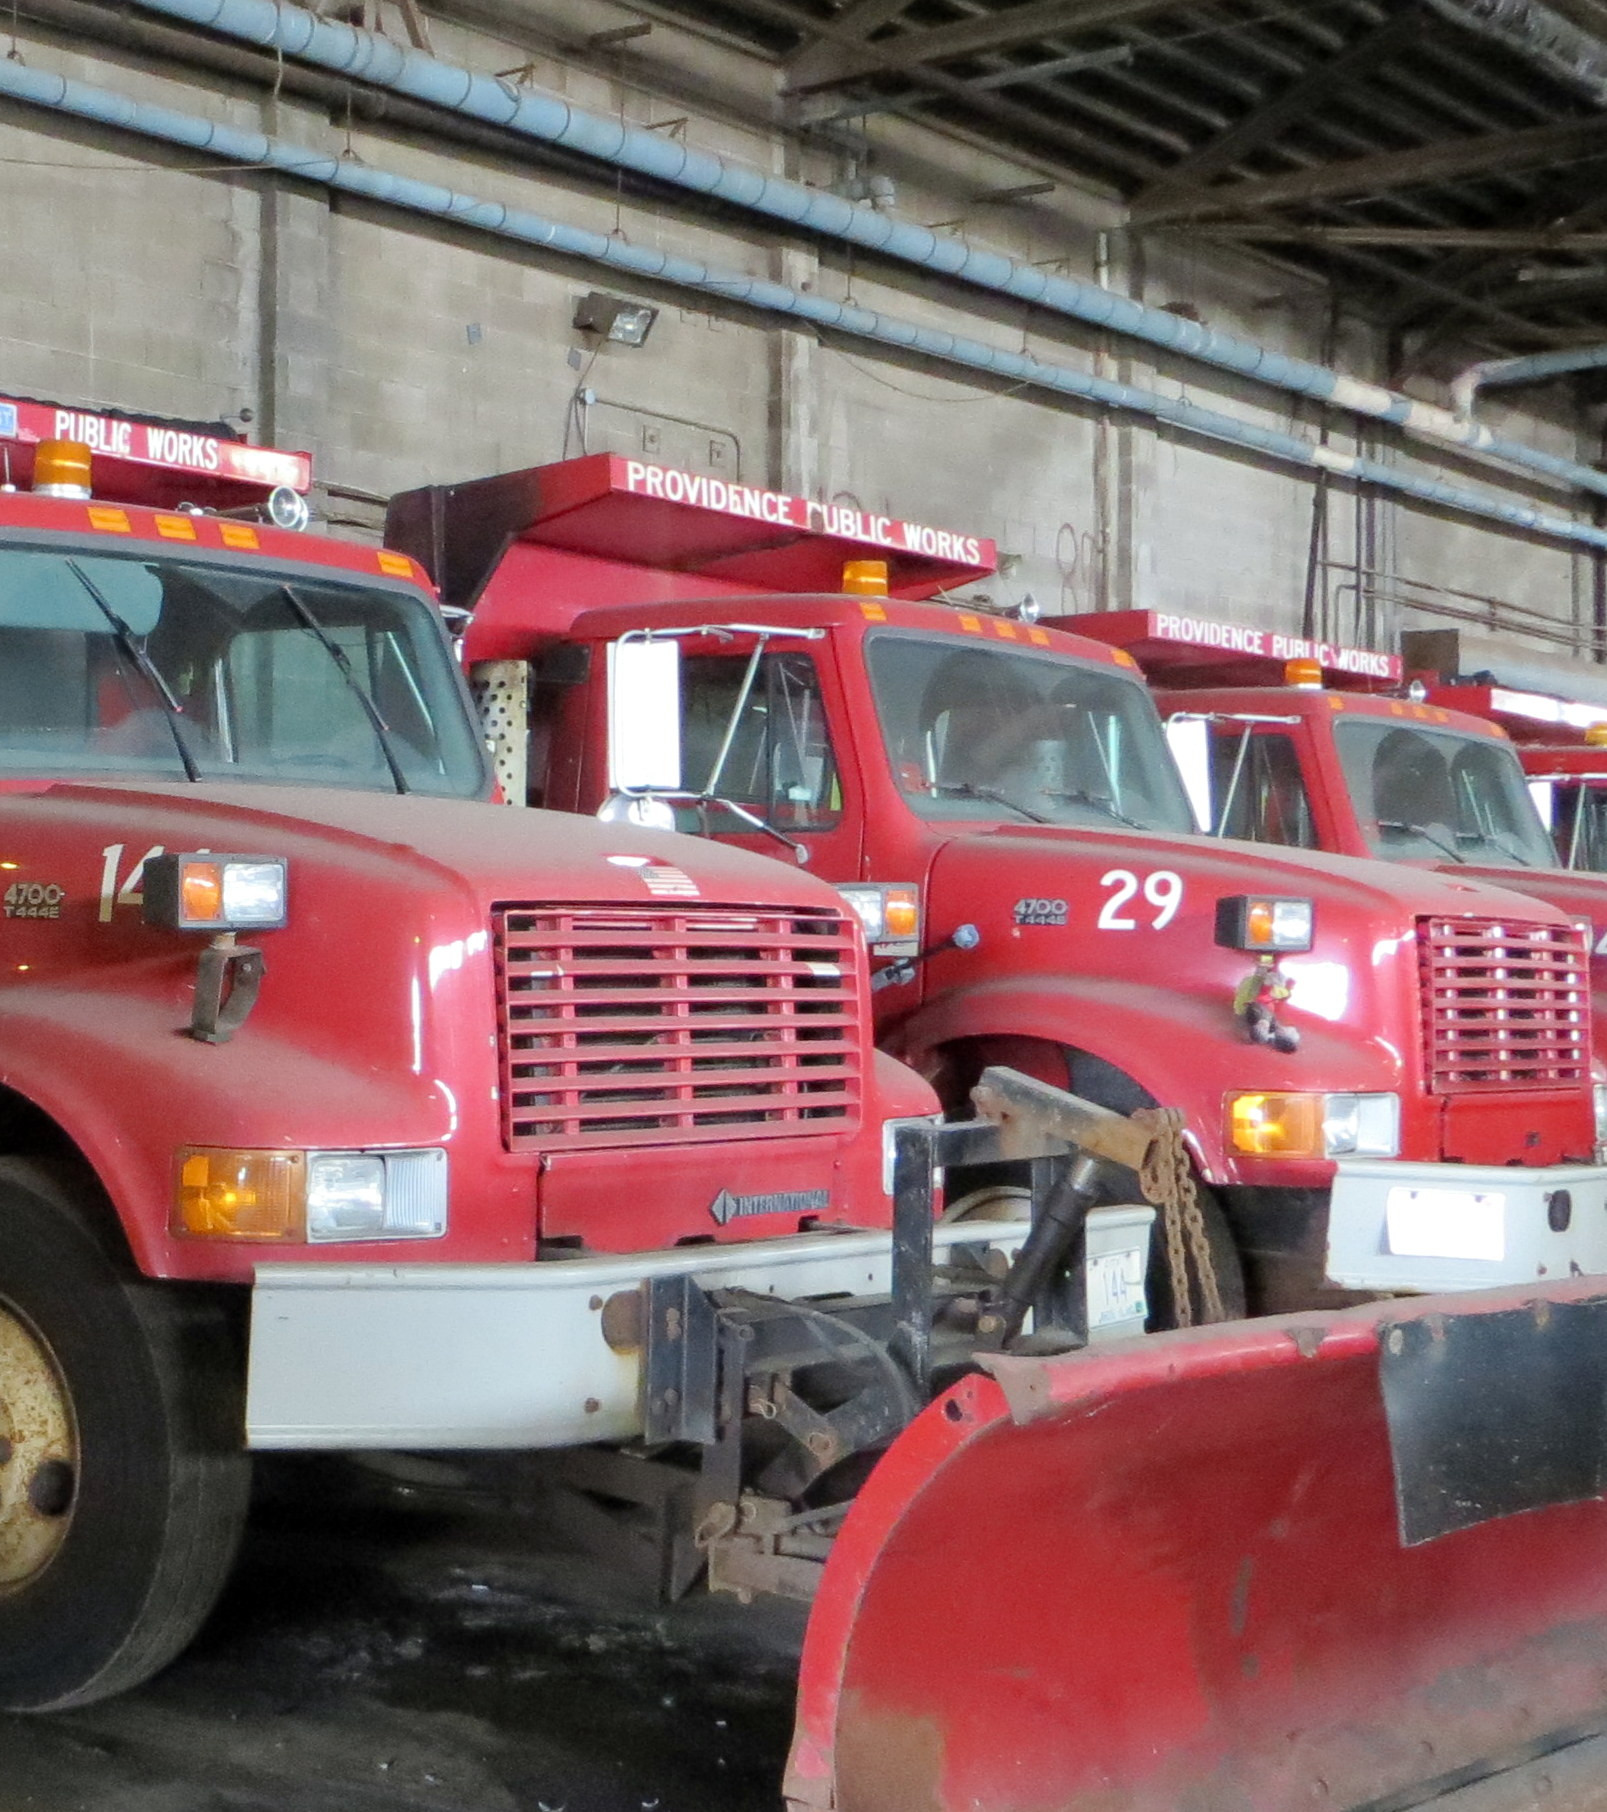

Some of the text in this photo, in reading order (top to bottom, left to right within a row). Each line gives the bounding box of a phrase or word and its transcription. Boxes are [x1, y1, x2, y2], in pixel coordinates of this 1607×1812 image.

[54, 411, 131, 454] PUBLIC
[147, 427, 218, 470] WORKS
[626, 461, 981, 566] PROVIDENCE PUBLIC WORKS
[1156, 614, 1390, 676] PROVIDENCE PUBLIC WORKS
[3, 906, 60, 918] T444E
[4, 883, 61, 905] 4700
[1014, 899, 1068, 914] 4700
[1098, 869, 1183, 931] 29
[738, 1190, 828, 1216] INTERNATIONAL
